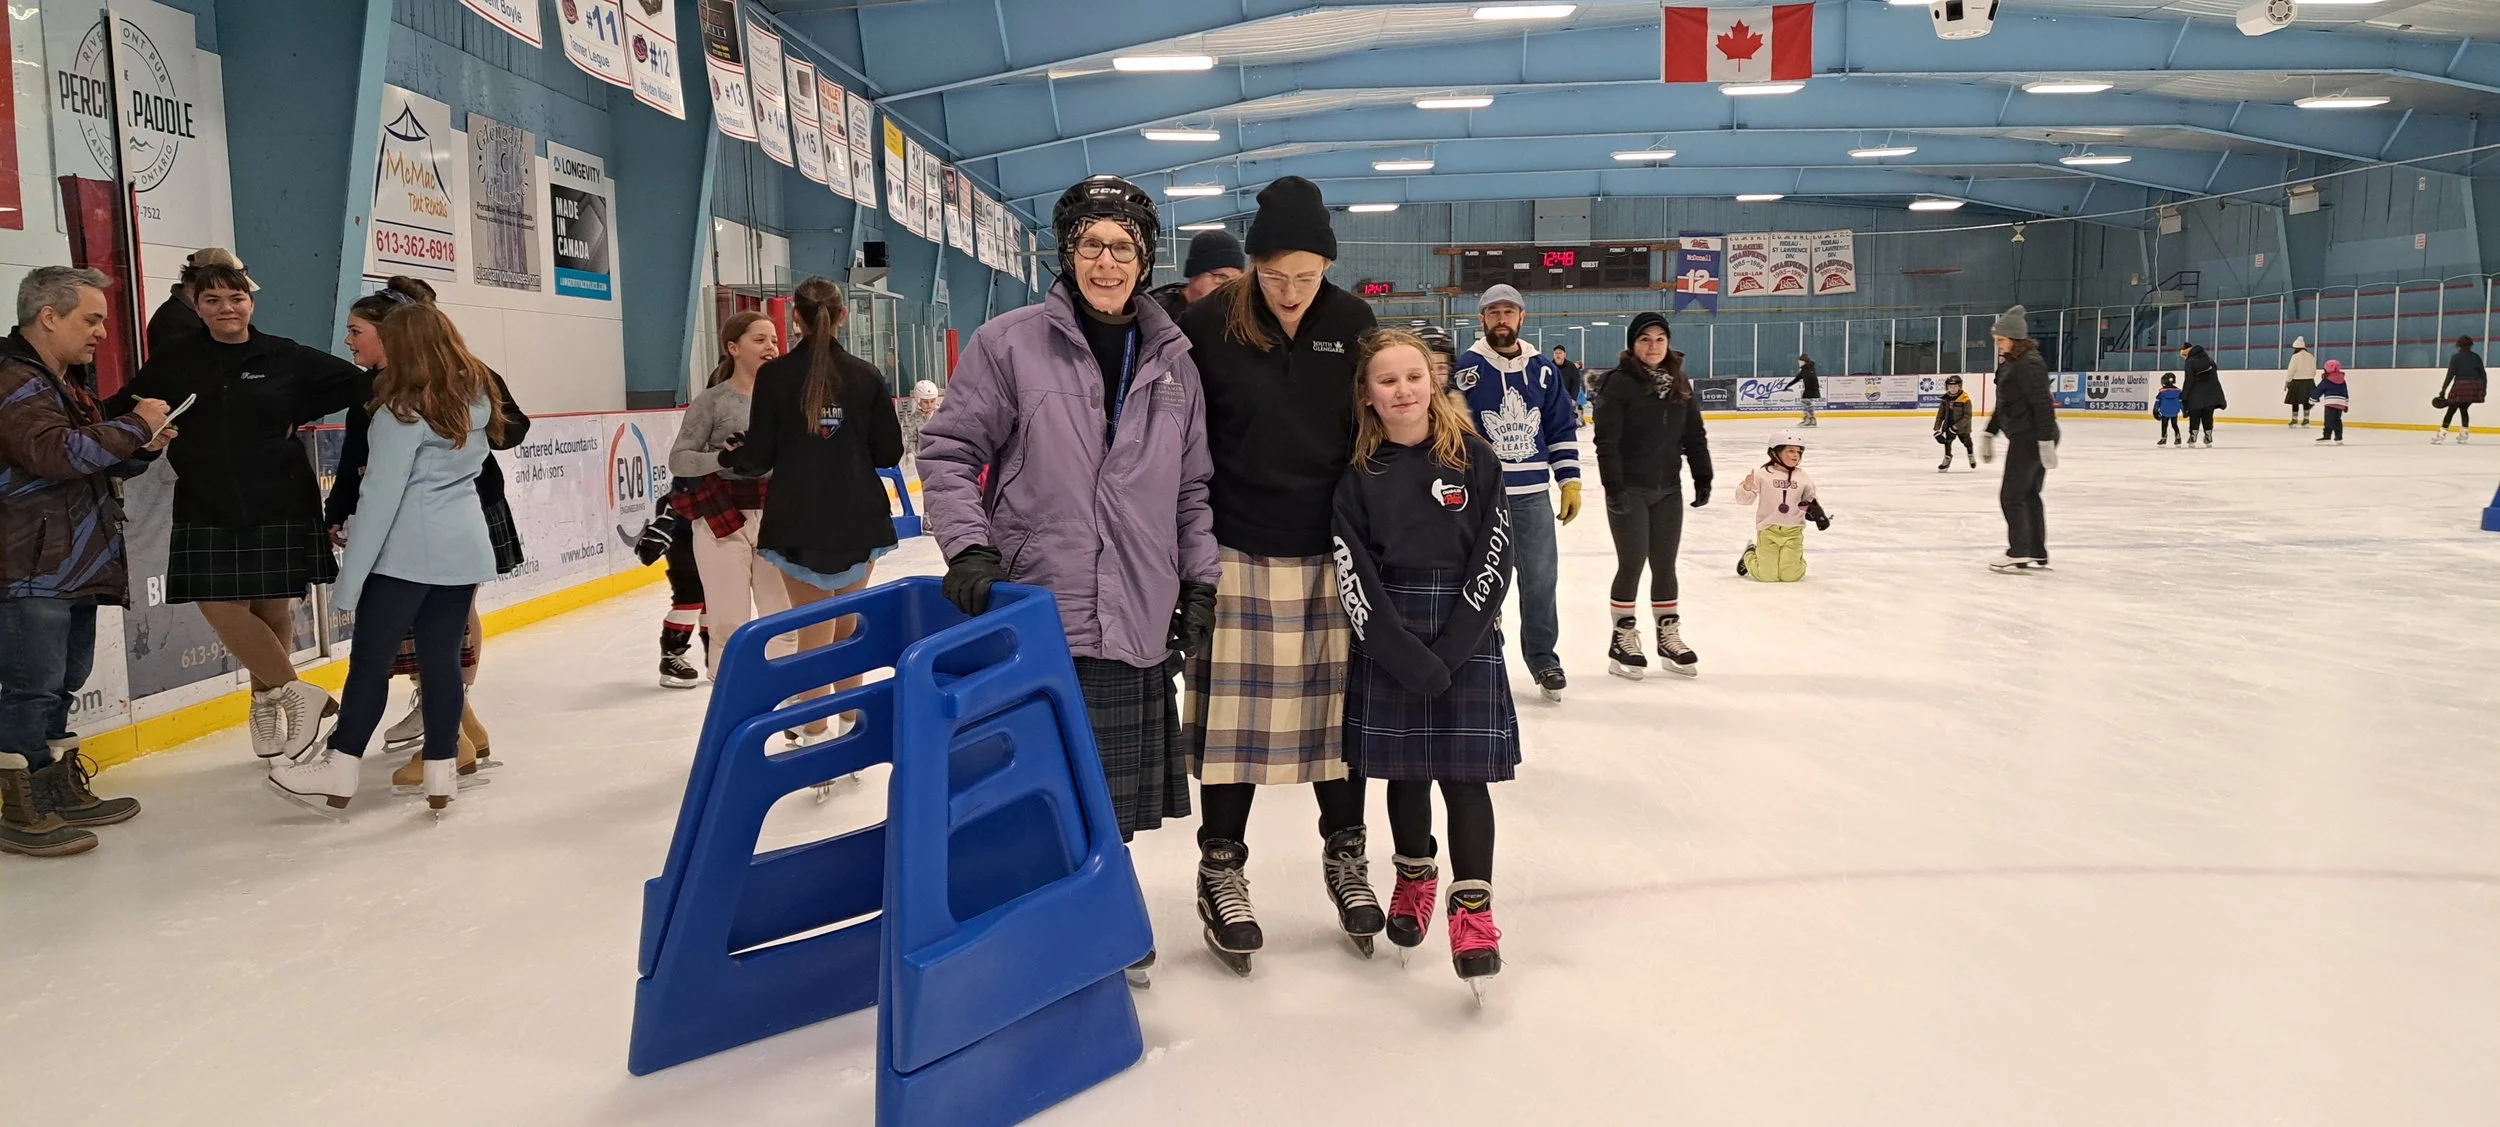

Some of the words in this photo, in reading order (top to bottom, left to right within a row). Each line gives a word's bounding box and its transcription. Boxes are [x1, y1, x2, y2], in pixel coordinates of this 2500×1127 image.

[501, 1, 522, 23] Boyle
[586, 5, 619, 46] #11
[149, 52, 166, 83] PUB
[650, 41, 670, 77] #12
[725, 82, 744, 107] #13
[133, 90, 195, 138] PADDLE
[141, 145, 172, 184] ONTARIO
[386, 149, 435, 189] McMac
[562, 158, 600, 184] LONGEVITY
[555, 197, 579, 219] MADE
[557, 217, 566, 236] IN
[376, 230, 455, 262] 613-362-6918
[558, 237, 589, 260] CANADA
[1729, 250, 1768, 263] CHAMPIONS
[1543, 251, 1574, 266] 12:48
[1770, 260, 1808, 274] CHAMPIONS
[1815, 260, 1853, 273] CHAMPIONS
[1687, 269, 1710, 293] 12
[1540, 366, 1552, 389] C
[1740, 378, 1793, 400] Roy's
[2111, 376, 2125, 385] John
[2127, 375, 2148, 384] Warden
[1494, 422, 1534, 436] TORONTO
[1503, 434, 1528, 442] MAPLE
[514, 440, 553, 459] Chartered
[554, 436, 598, 455] Accountants
[1502, 443, 1529, 451] LEAFS
[515, 464, 531, 483] and
[532, 464, 565, 480] Advisors
[617, 456, 644, 501] EVB
[653, 464, 667, 481] EVB
[1773, 479, 1798, 490] OOPS
[560, 541, 604, 564] www.bdo.ca
[1463, 506, 1511, 612] Hockey
